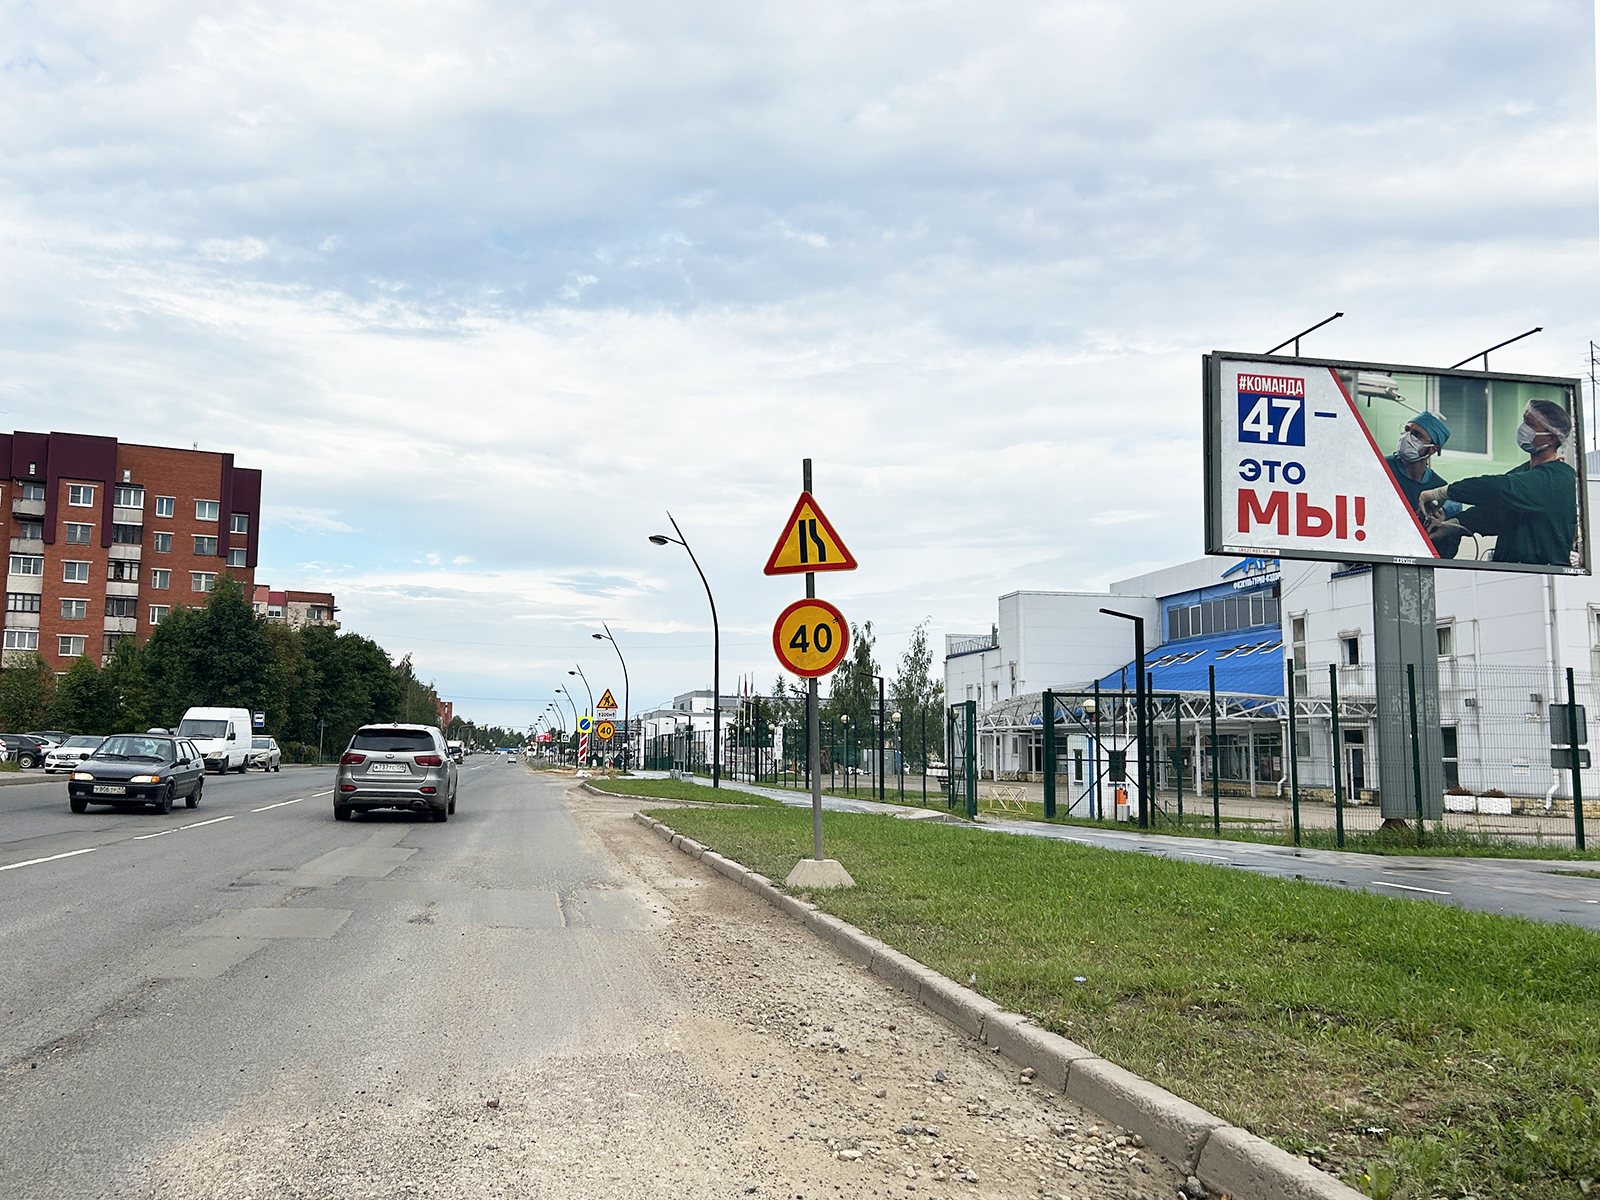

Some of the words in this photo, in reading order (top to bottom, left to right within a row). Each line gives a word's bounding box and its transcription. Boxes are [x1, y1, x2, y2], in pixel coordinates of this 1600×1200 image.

[1239, 375, 1304, 395] #КОМАНДА
[1242, 396, 1301, 443] 47
[1237, 488, 1366, 541] МЫ!
[789, 623, 833, 653] 40
[600, 727, 611, 735] 40
